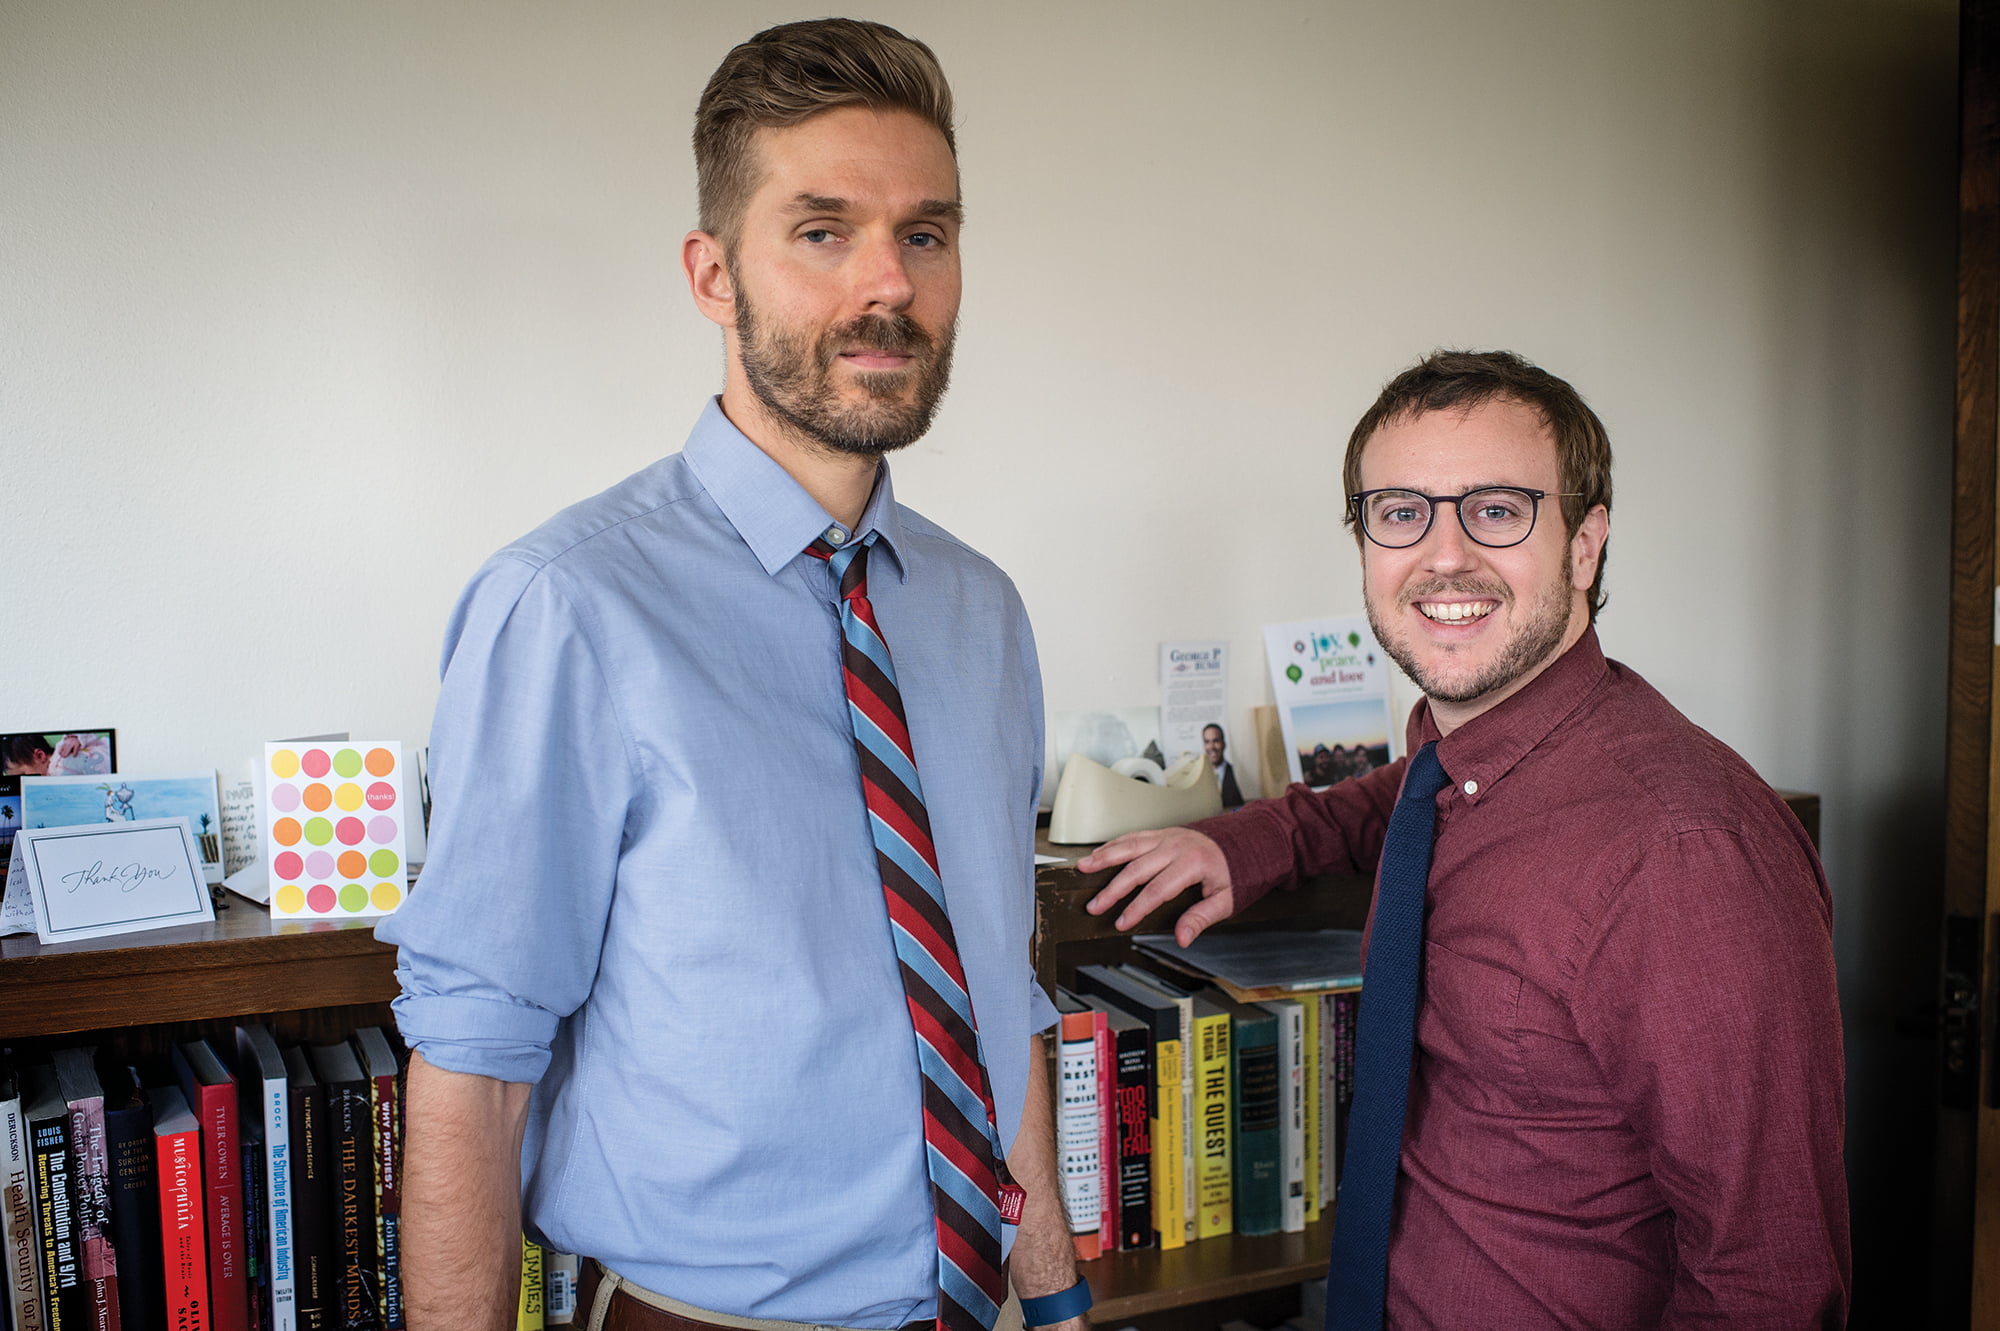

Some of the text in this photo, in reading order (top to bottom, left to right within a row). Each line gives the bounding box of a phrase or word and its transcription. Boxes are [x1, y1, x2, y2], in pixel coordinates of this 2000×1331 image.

[367, 793, 395, 801] thanks!
[61, 860, 177, 893] Thank You
[1203, 1024, 1213, 1061] YERGIN
[1216, 1023, 1227, 1058] DANIEL
[1064, 1069, 1095, 1080] REST
[1206, 1065, 1225, 1100] THE
[273, 1092, 281, 1129] BROCK
[342, 1089, 352, 1132] BRACKEN
[1117, 1085, 1146, 1105] TOO
[1122, 1102, 1147, 1124] BIG
[7, 1113, 19, 1161] DERICKSON
[37, 1135, 64, 1147] FISHER
[38, 1126, 61, 1137] LOUIS
[216, 1106, 228, 1179] TYLER COWEN
[382, 1101, 393, 1189] WHY PARTIES?
[1123, 1133, 1152, 1157] FAIL
[1125, 1120, 1144, 1139] TO
[1204, 1103, 1226, 1158] QUEST
[37, 1154, 51, 1200] Recurring
[72, 1112, 94, 1242] Great Power Politics
[90, 1123, 109, 1224] The Tragedy of
[10, 1170, 29, 1224] Health
[272, 1144, 291, 1281] The Structure of American Industry
[42, 1201, 54, 1237] Threats
[49, 1150, 77, 1288] The Constitution and 9/11
[220, 1195, 233, 1279] AVERAGE IS OVER
[342, 1136, 360, 1320] THE DARKEST MINDS
[16, 1227, 34, 1293] Security
[45, 1239, 54, 1248] to
[47, 1250, 59, 1295] America's
[94, 1278, 105, 1298] John
[385, 1219, 399, 1323] John H. Aldrich
[23, 1298, 37, 1320] for
